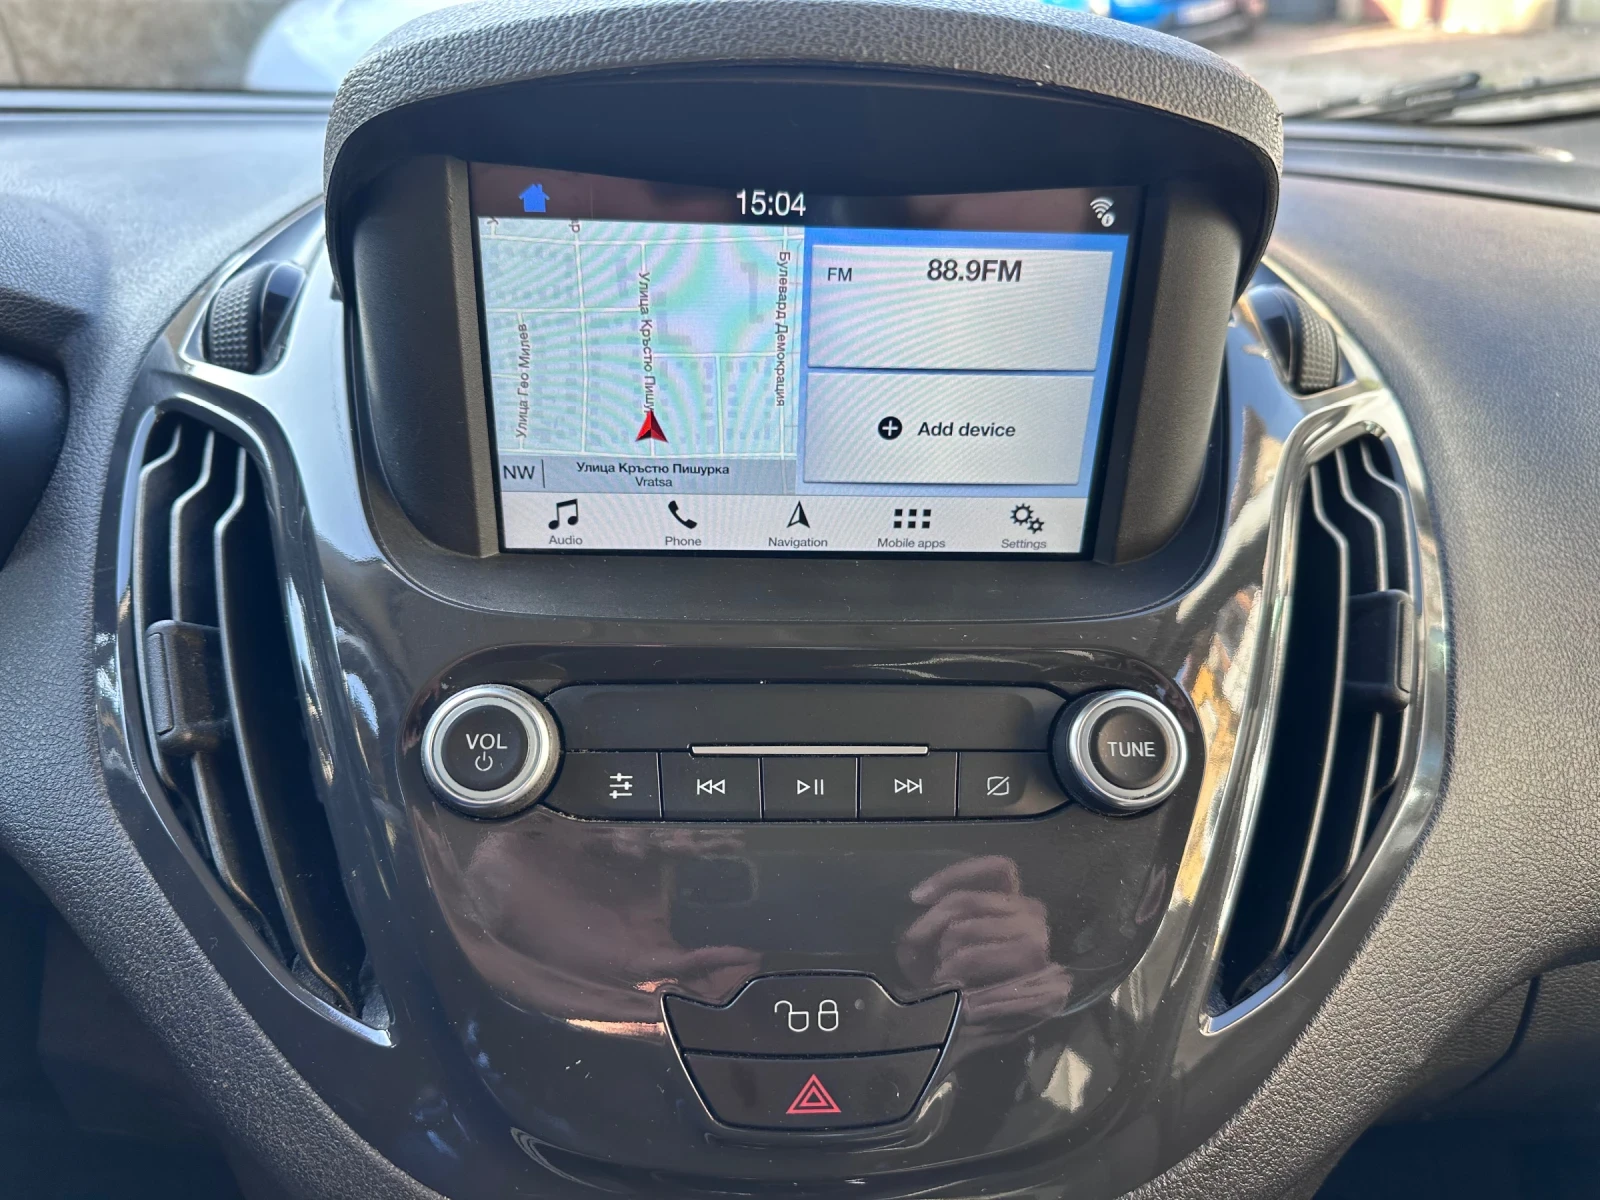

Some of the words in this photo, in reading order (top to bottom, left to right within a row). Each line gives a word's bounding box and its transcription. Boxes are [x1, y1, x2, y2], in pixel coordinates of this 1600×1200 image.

[736, 188, 807, 217] 15:04
[827, 266, 853, 282] FM
[926, 258, 1022, 283] 88.9FM
[639, 272, 651, 315] Улица
[777, 251, 791, 319] Булевард
[518, 323, 531, 369] Милев
[640, 319, 653, 372] Кръстю
[774, 323, 789, 407] Демокрация
[517, 372, 529, 396] Гео
[516, 400, 529, 438] Улица
[917, 422, 953, 437] Add
[958, 422, 1016, 438] device
[503, 465, 535, 480] NW
[576, 461, 615, 474] Улица
[618, 463, 669, 475] Кръстю
[672, 464, 730, 476] Пишурка
[635, 476, 673, 488] Vratsa
[549, 534, 583, 546] Audio
[665, 535, 702, 547] Phone
[768, 536, 828, 549] Navigation
[877, 537, 915, 548] Mobile
[917, 539, 946, 550] apps
[1001, 538, 1047, 551] Settings
[465, 733, 508, 751] VOL
[1106, 740, 1157, 758] TUNE
